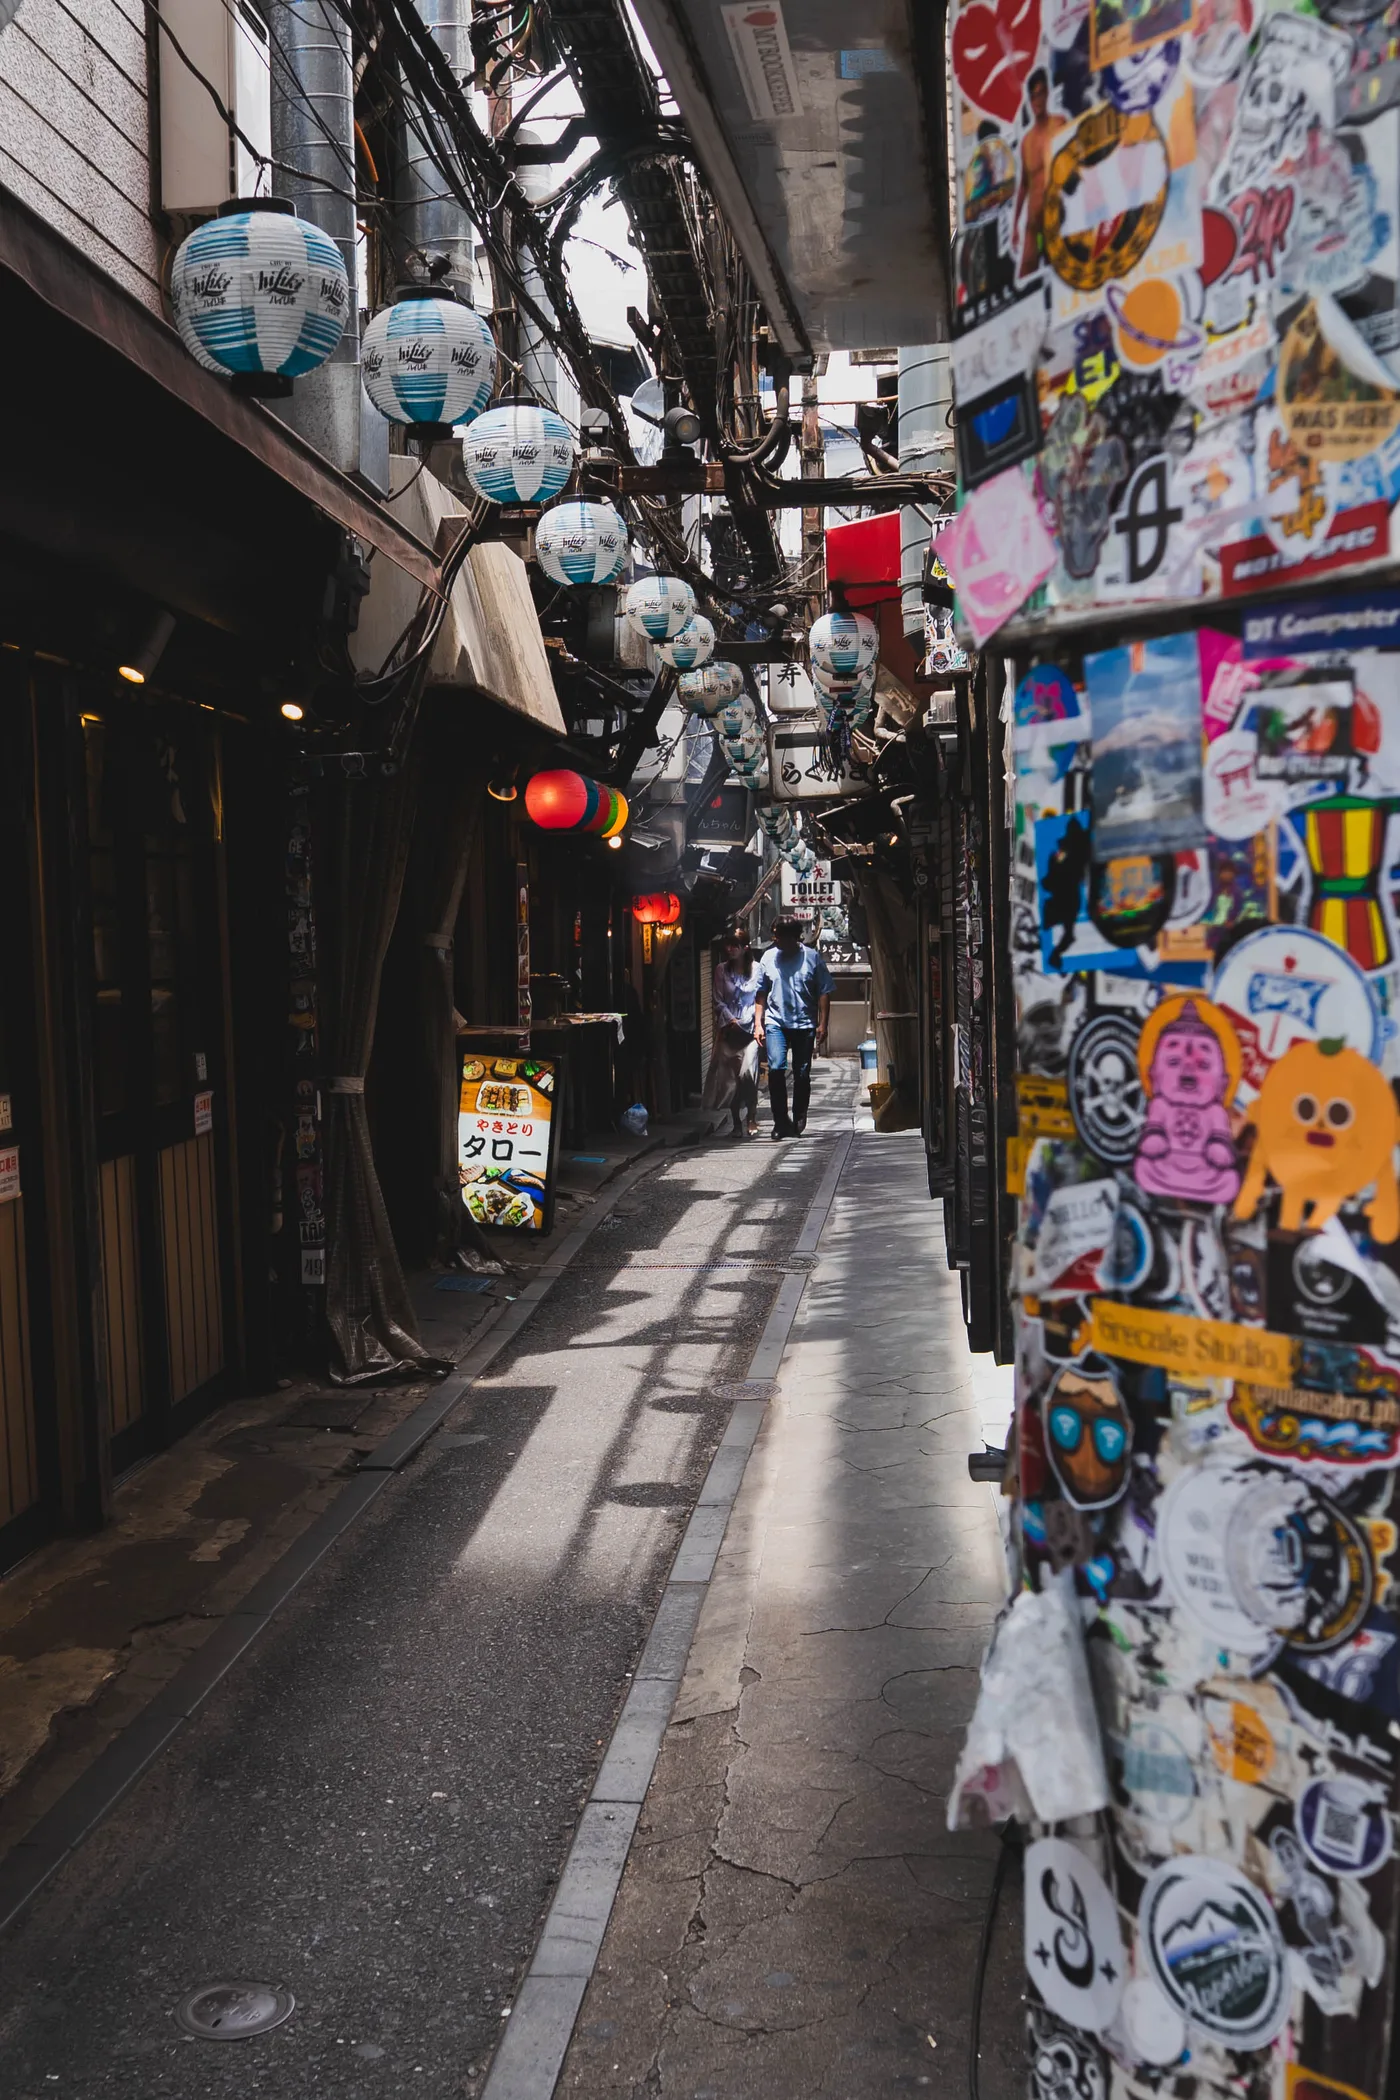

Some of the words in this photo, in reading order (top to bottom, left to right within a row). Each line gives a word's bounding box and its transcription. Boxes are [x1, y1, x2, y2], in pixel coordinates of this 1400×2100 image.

[789, 882, 835, 895] TOILET
[476, 1118, 534, 1137] やきとり
[463, 1135, 542, 1162] タロー
[1194, 1326, 1279, 1372] Studio
